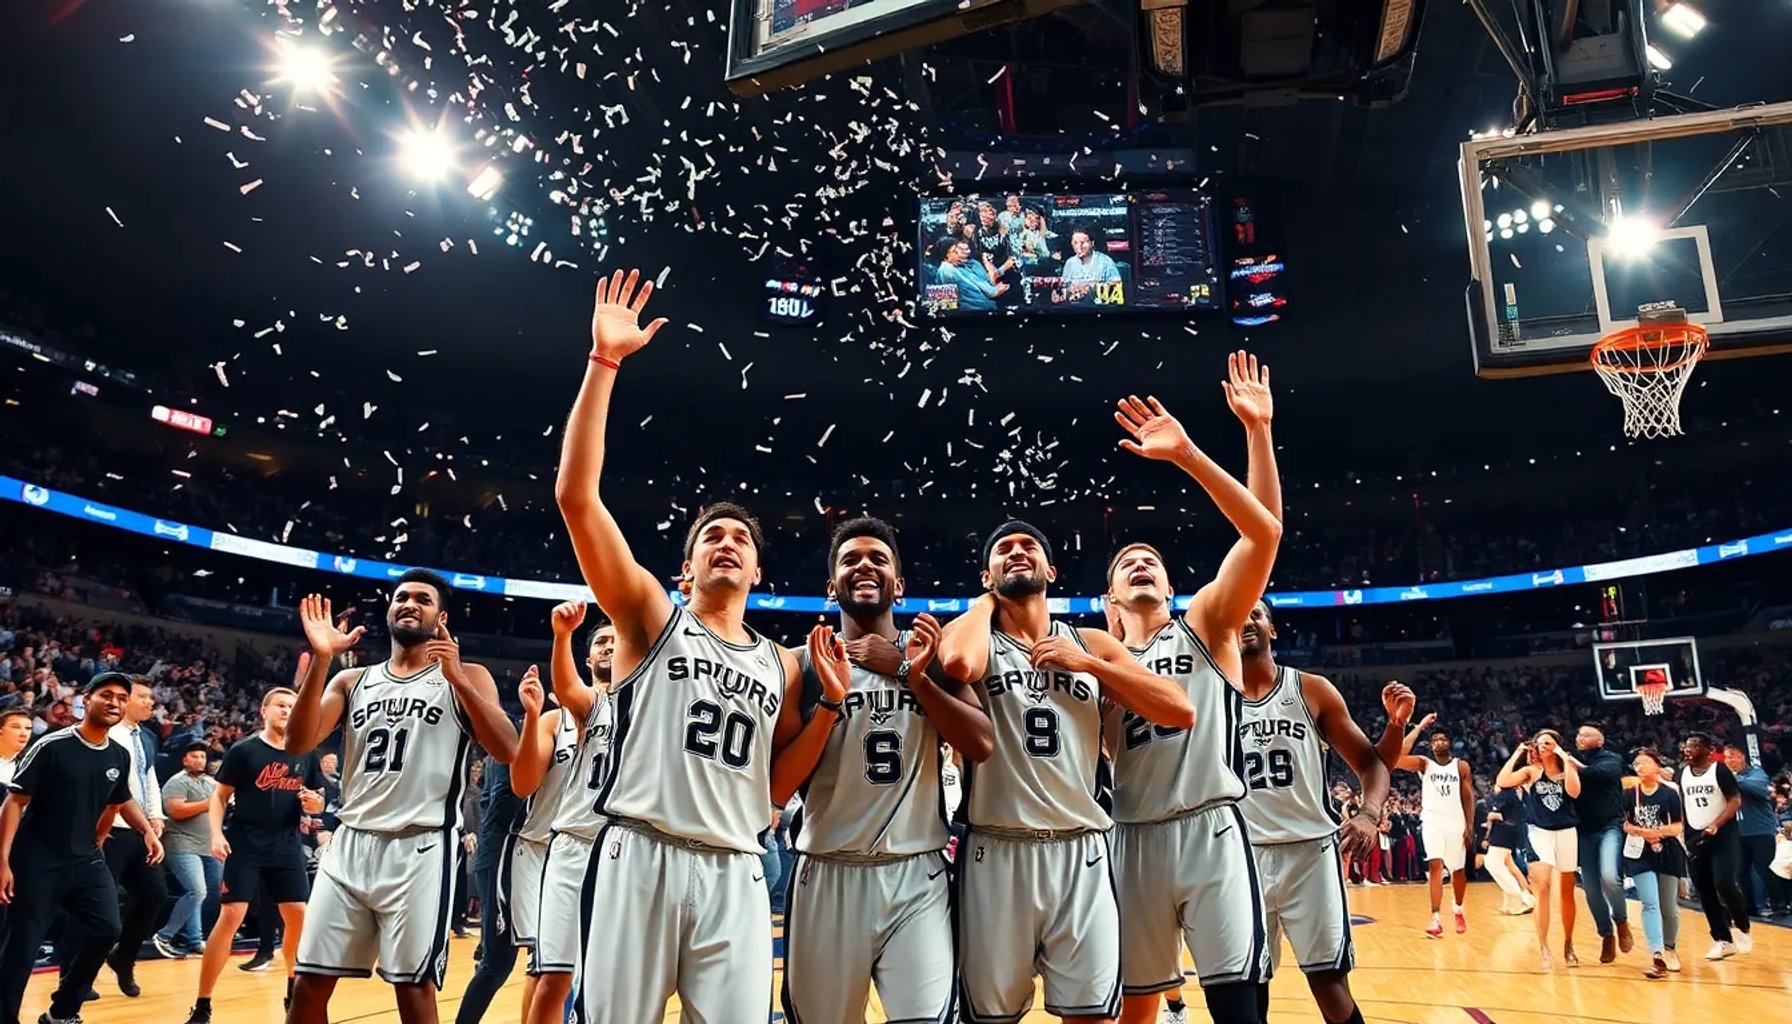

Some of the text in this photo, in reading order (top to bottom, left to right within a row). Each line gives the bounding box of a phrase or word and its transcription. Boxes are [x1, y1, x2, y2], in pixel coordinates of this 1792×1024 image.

[363, 728, 408, 774] 21
[683, 699, 757, 770] 20
[1023, 705, 1062, 759] 9
